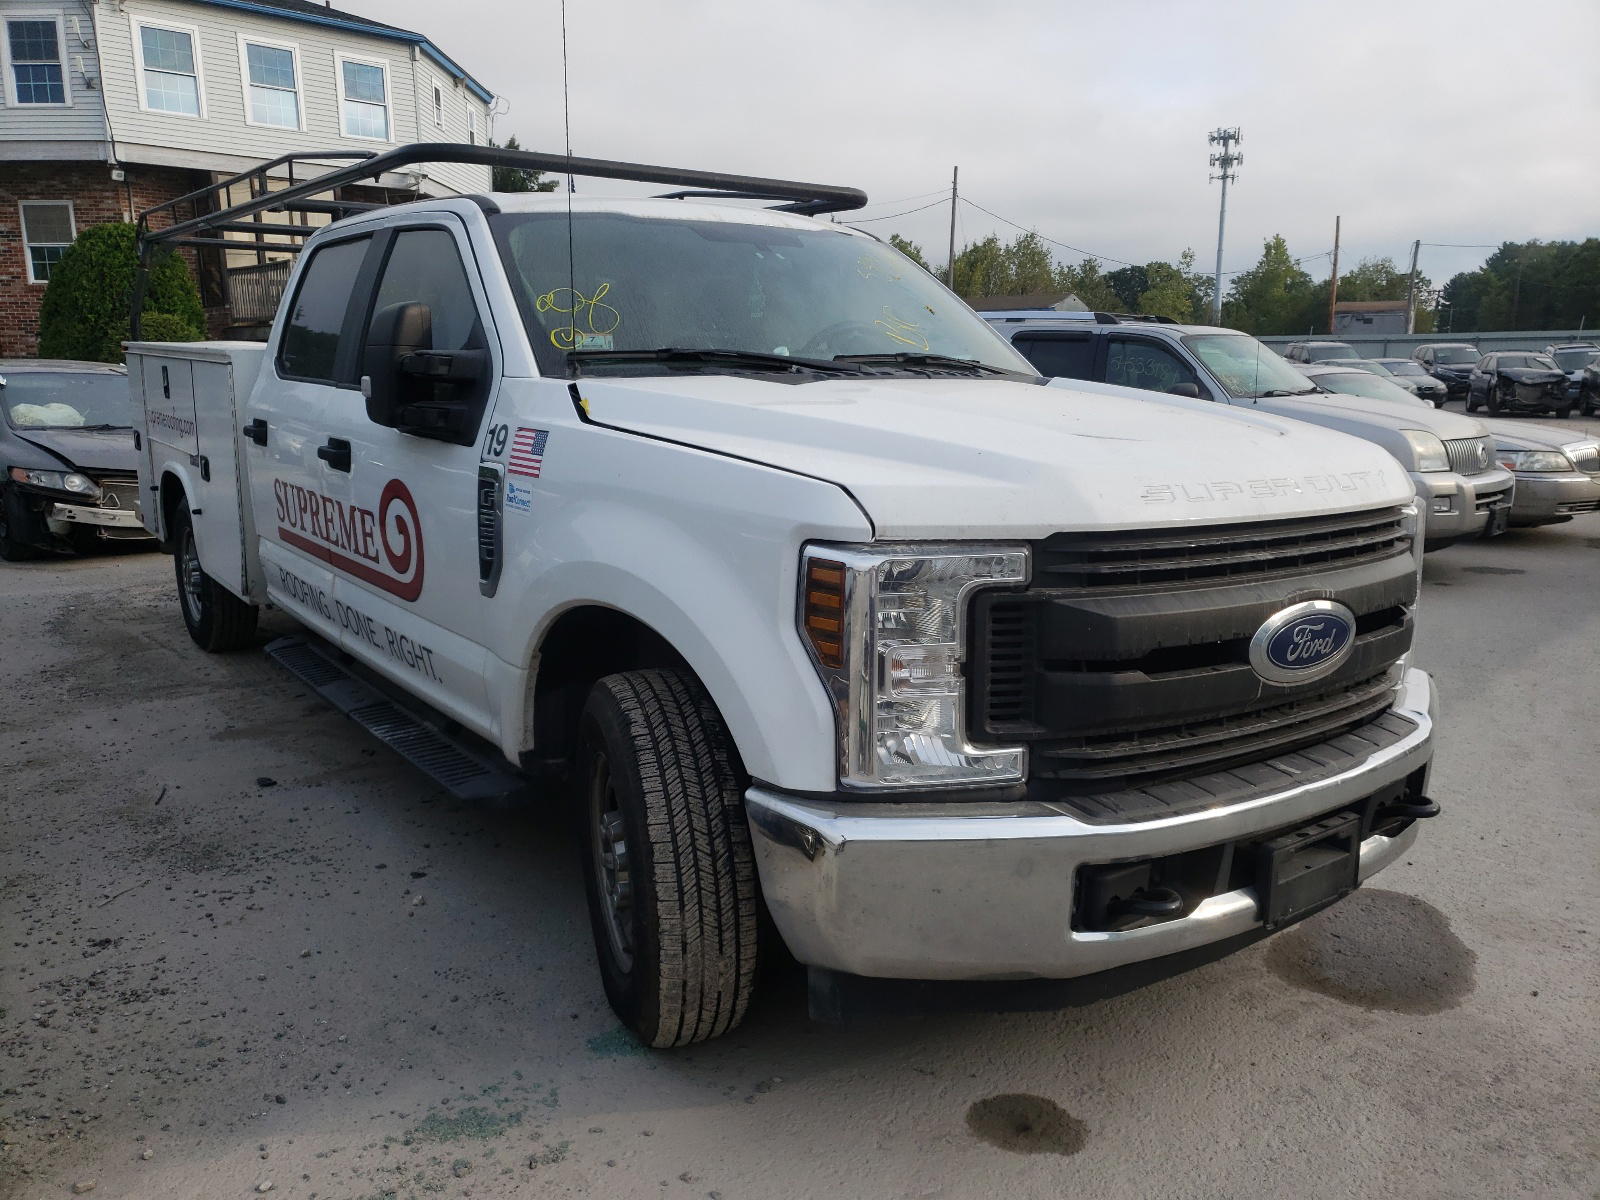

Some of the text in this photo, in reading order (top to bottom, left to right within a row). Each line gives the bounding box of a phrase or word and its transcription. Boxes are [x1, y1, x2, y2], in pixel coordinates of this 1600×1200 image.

[487, 423, 509, 457] 19
[1141, 470, 1386, 505] SUPER DUTY
[274, 478, 380, 564] SUPREME
[279, 567, 443, 684] ROOFING. DONE. RIGHT.
[1286, 622, 1336, 661] Ford
